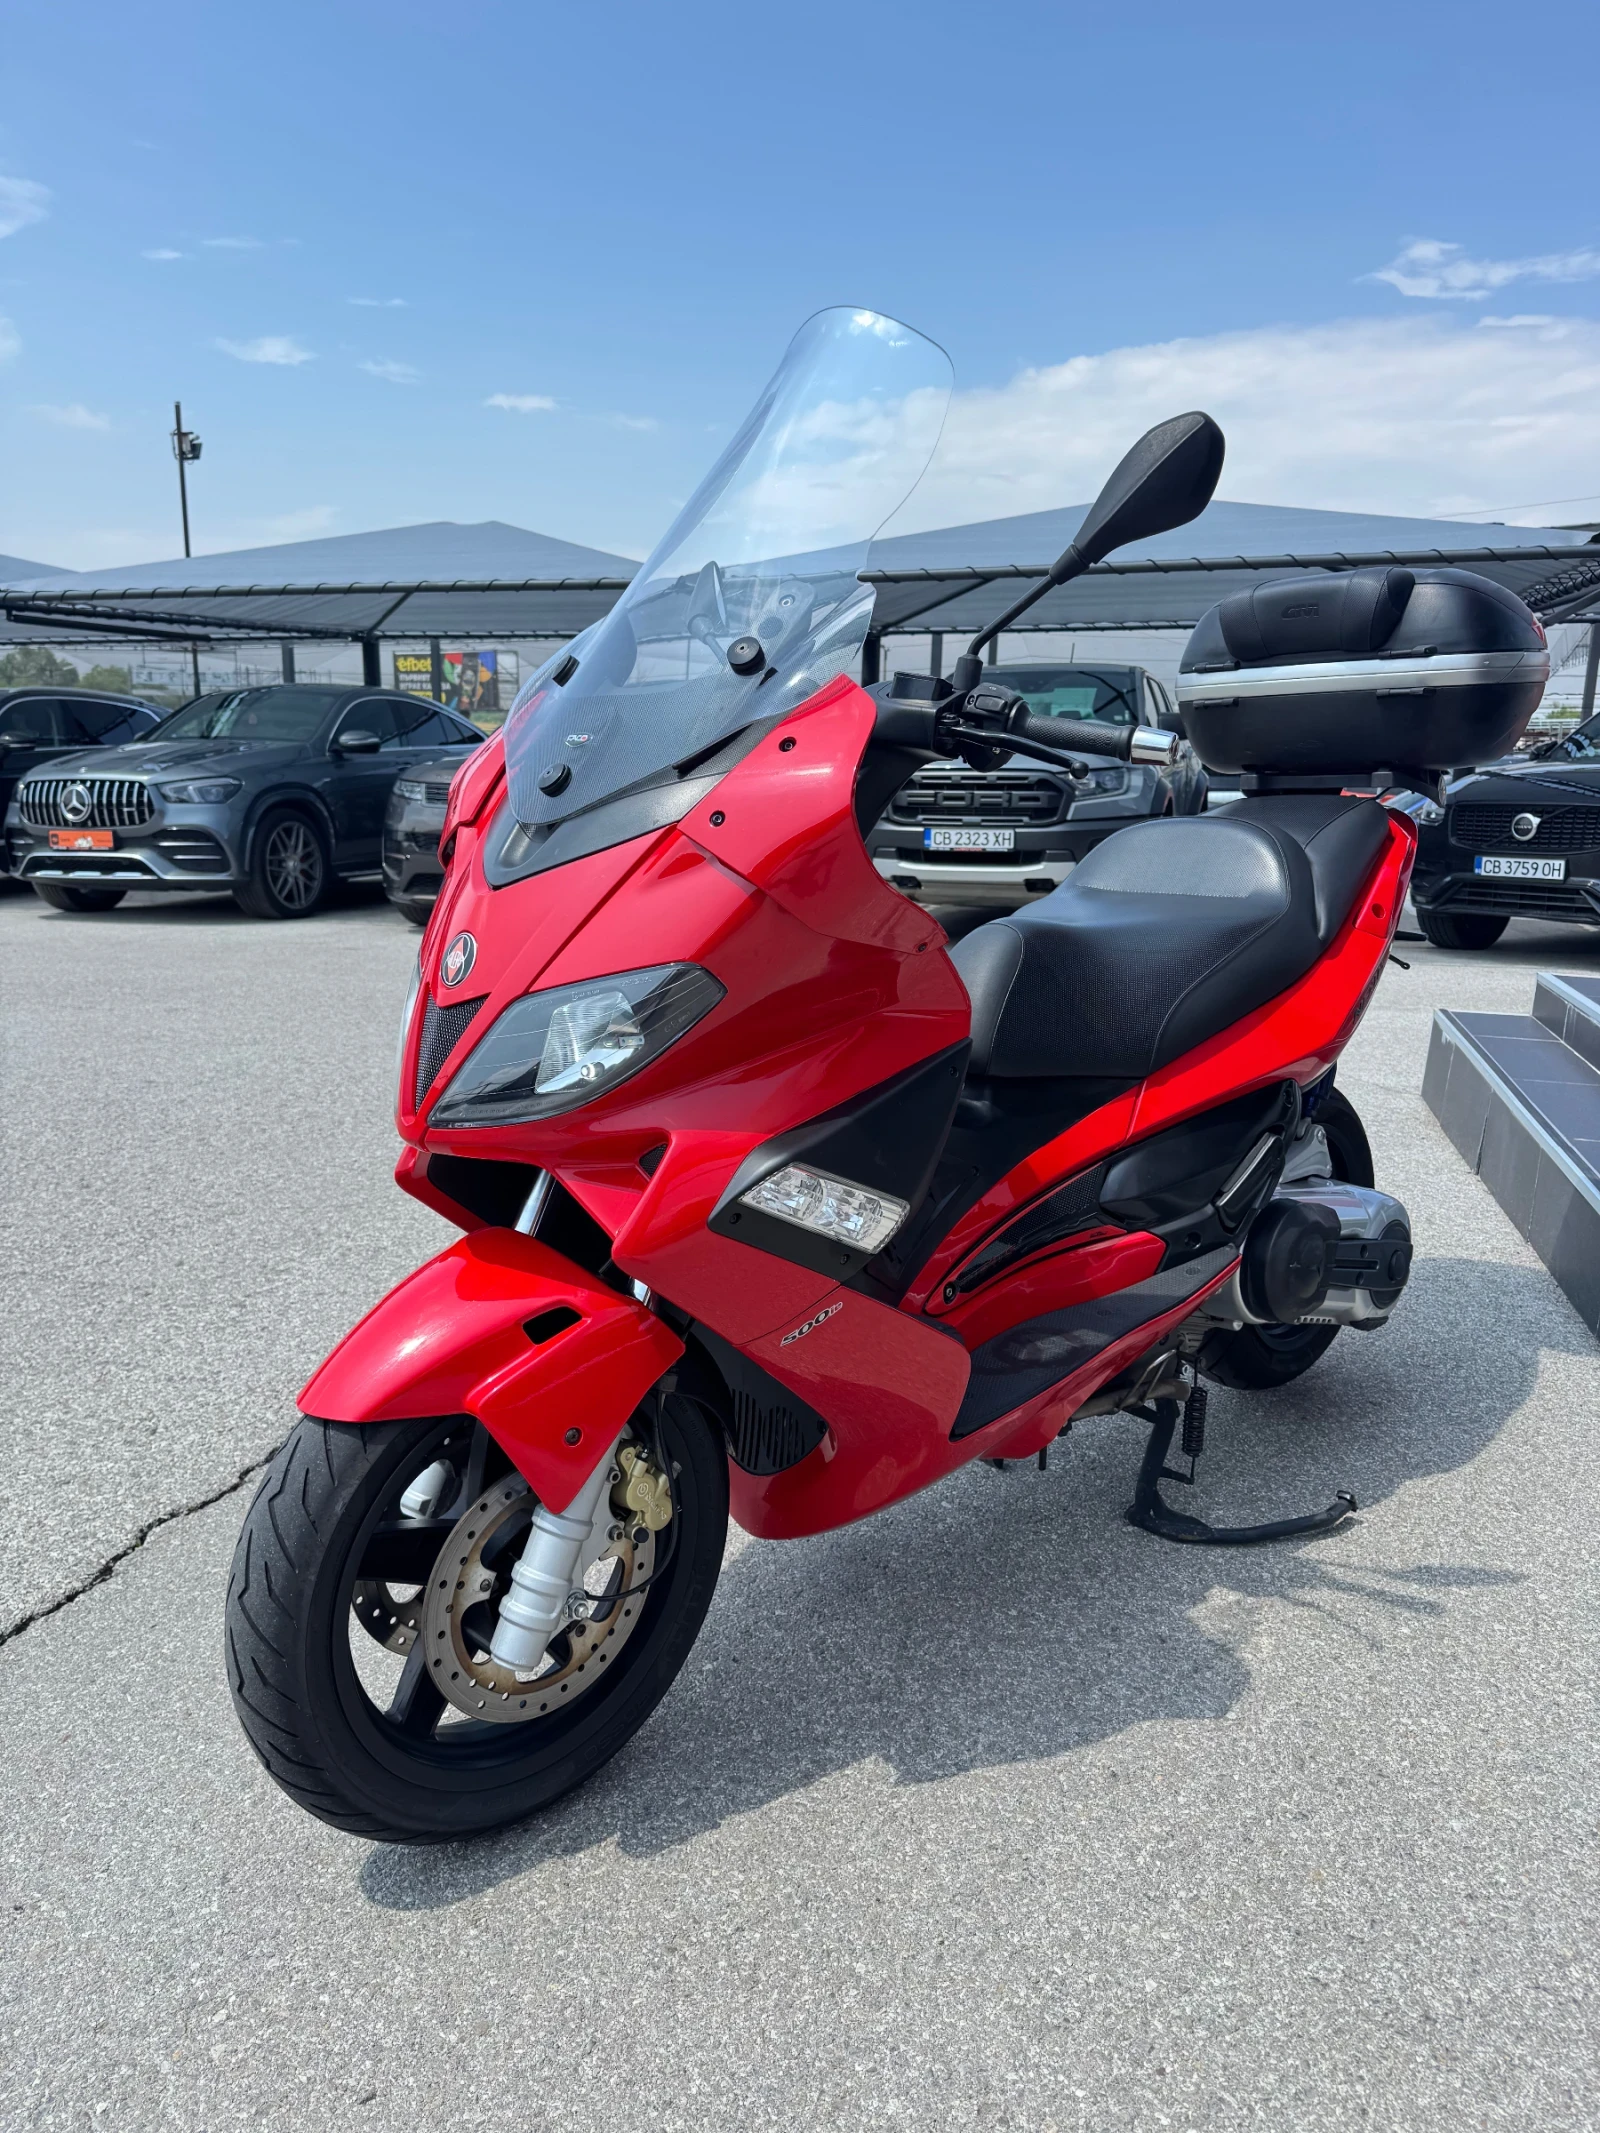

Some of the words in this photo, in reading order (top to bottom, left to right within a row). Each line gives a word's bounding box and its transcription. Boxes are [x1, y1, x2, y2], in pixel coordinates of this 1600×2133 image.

[899, 790, 1047, 808] FORD
[933, 832, 952, 846] CB
[955, 832, 989, 846] 2323
[993, 832, 1012, 847] XH
[1483, 859, 1502, 874] CB
[1504, 860, 1539, 876] 3759
[1542, 862, 1562, 877] OH
